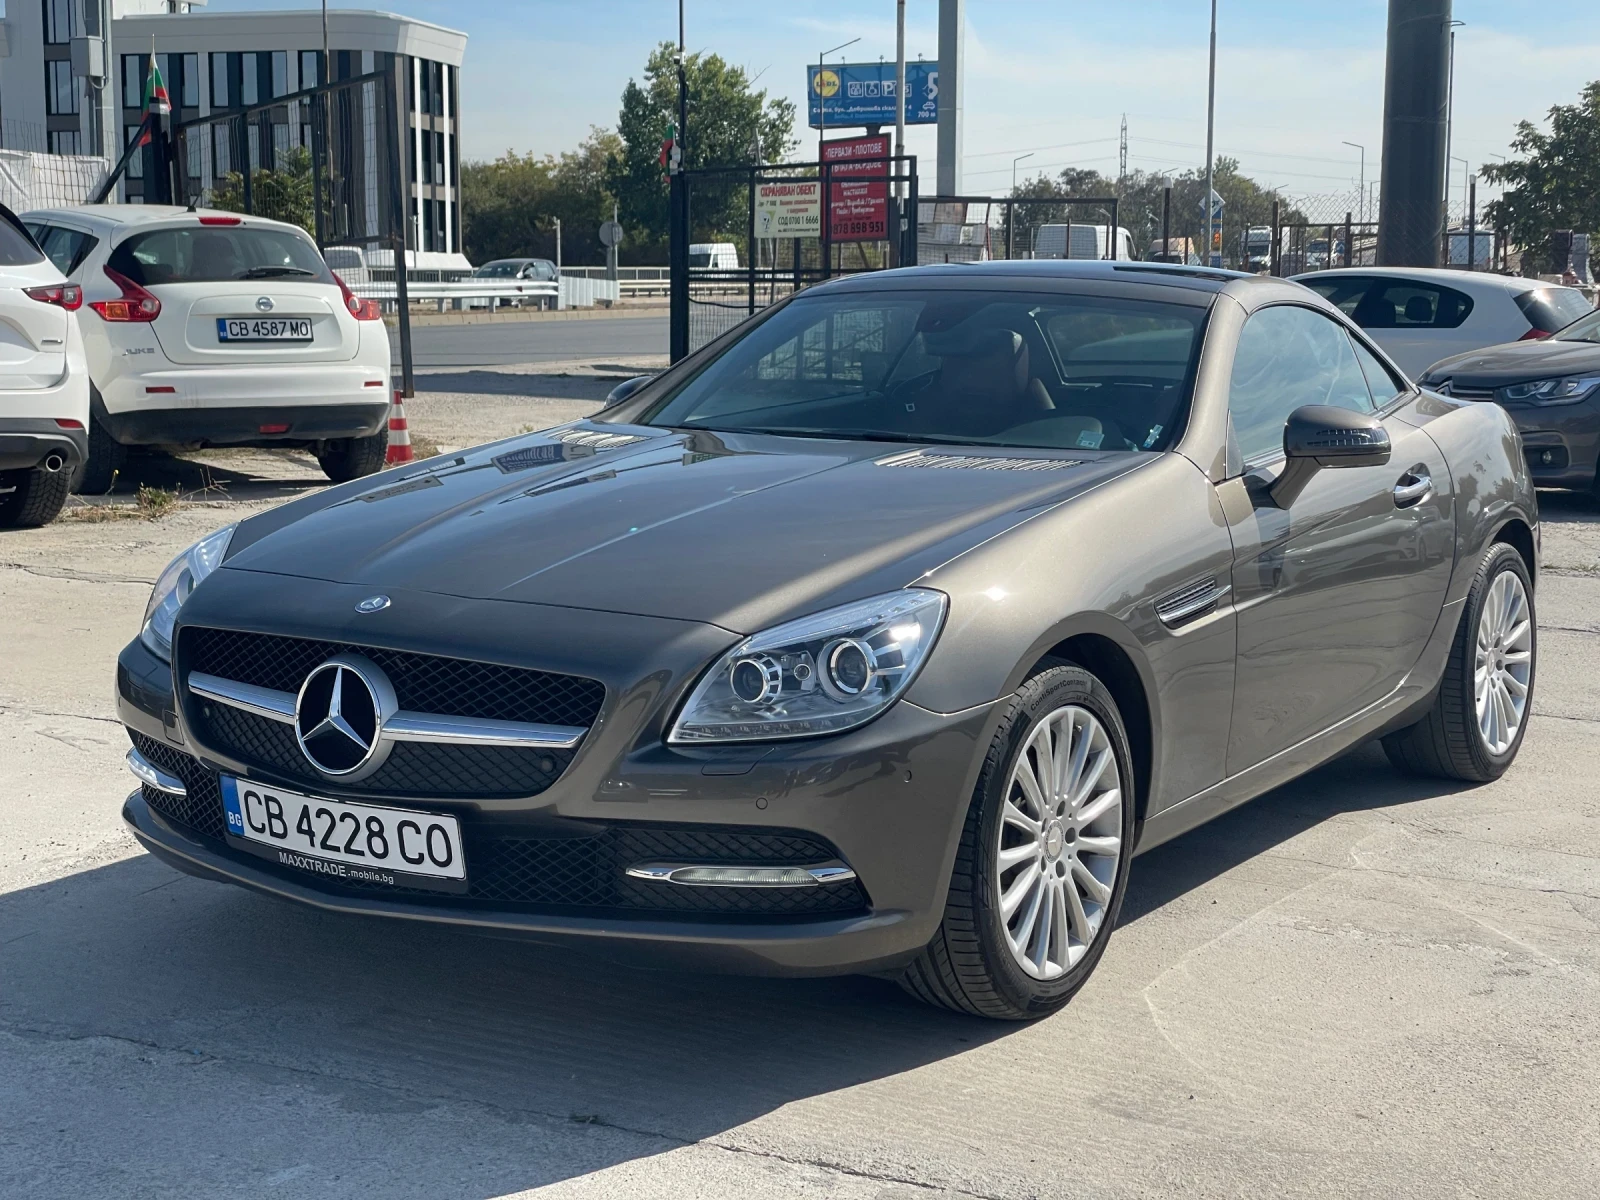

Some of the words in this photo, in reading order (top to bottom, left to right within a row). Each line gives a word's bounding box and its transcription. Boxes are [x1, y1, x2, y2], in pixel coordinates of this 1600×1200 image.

[796, 184, 817, 196] ОБЕКТ
[778, 216, 788, 226] СОД
[788, 216, 801, 225] 0700
[805, 215, 819, 225] 6666
[832, 223, 849, 235] 878
[850, 222, 868, 234] 898
[869, 221, 884, 233] 951
[252, 322, 287, 337] 4587
[122, 347, 155, 356] JUKE
[228, 811, 242, 826] BG
[243, 789, 288, 840] CB
[296, 804, 390, 860] 4228
[278, 851, 347, 877] MAXXTRADE
